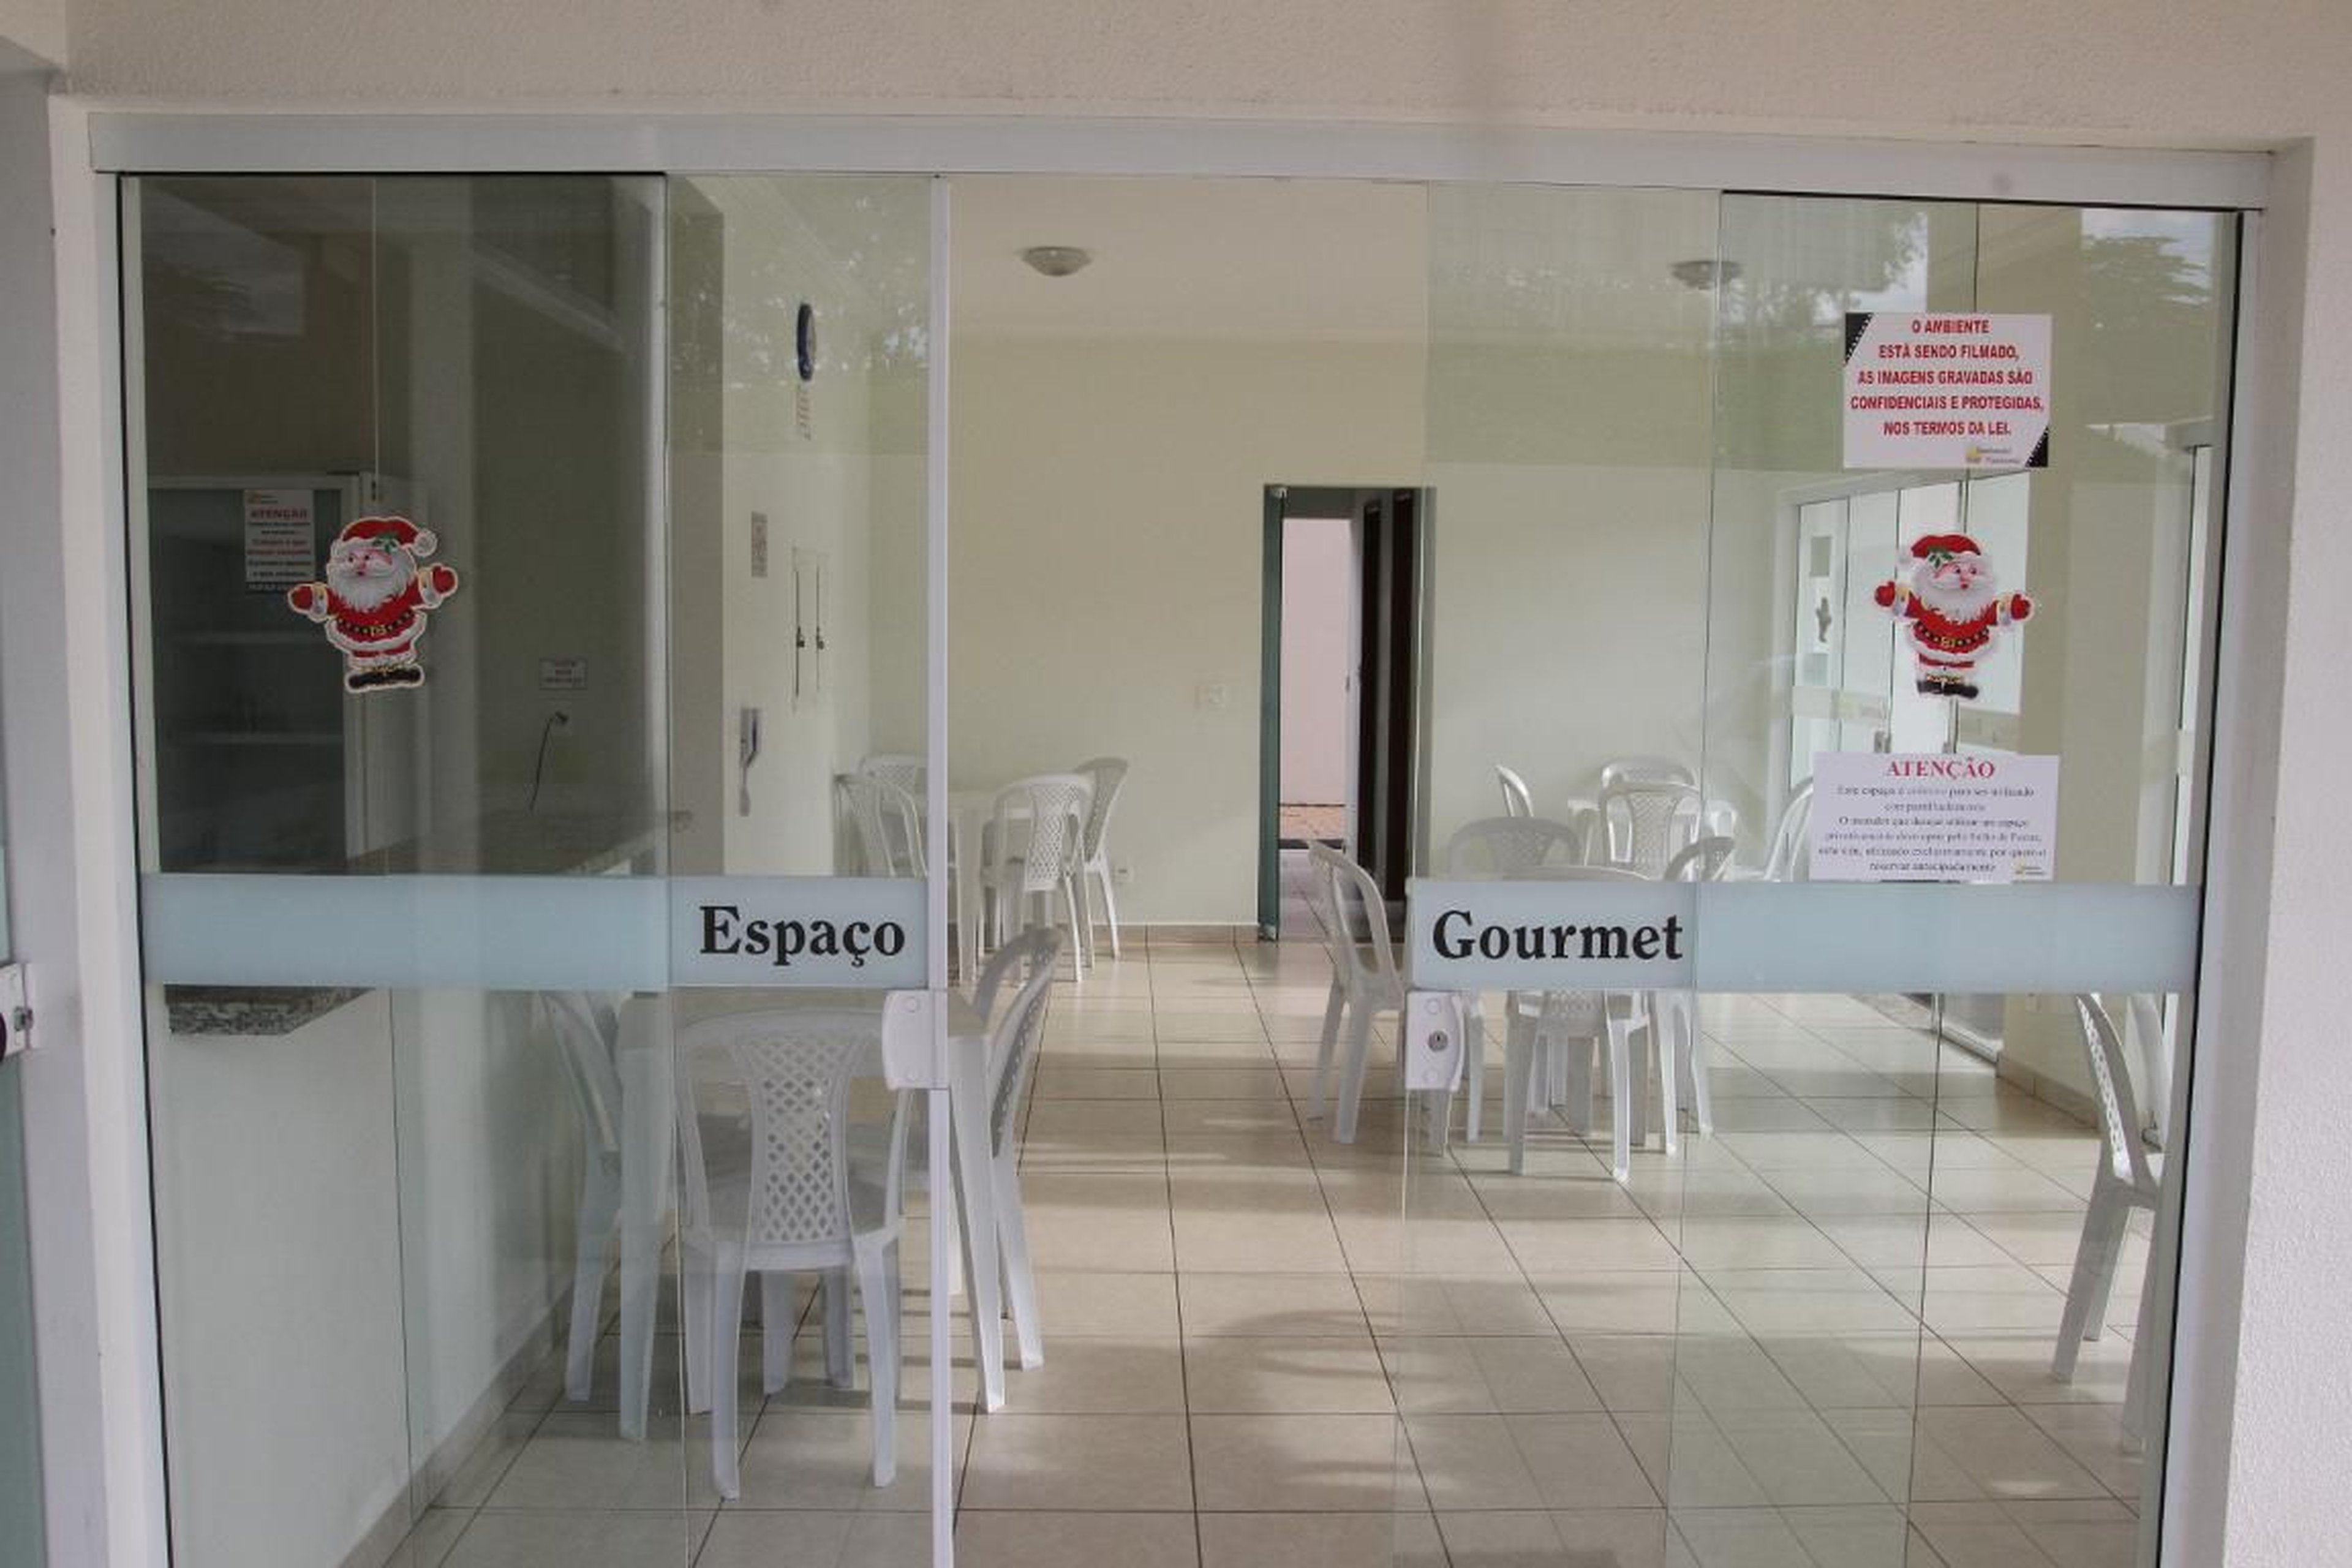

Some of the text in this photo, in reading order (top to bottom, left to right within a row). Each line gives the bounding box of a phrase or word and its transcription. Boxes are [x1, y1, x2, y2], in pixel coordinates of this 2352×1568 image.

[1912, 319, 1989, 333] O AMBIENTE
[1879, 344, 2019, 360] ESTÁ SENDO FILMADO,
[1858, 368, 2033, 385] AS IMAGENS GRAVADAS SÃO
[1851, 396, 2044, 412] CONFIDENCIAIS E PROTEGIDAS,
[1883, 421, 2011, 435] NOS TERMOS DA LEI.
[1886, 757, 1996, 780] ATENÇÃO
[1839, 816, 1849, 825] O
[699, 906, 905, 967] Espaço
[1432, 910, 1683, 960] Gourmet
